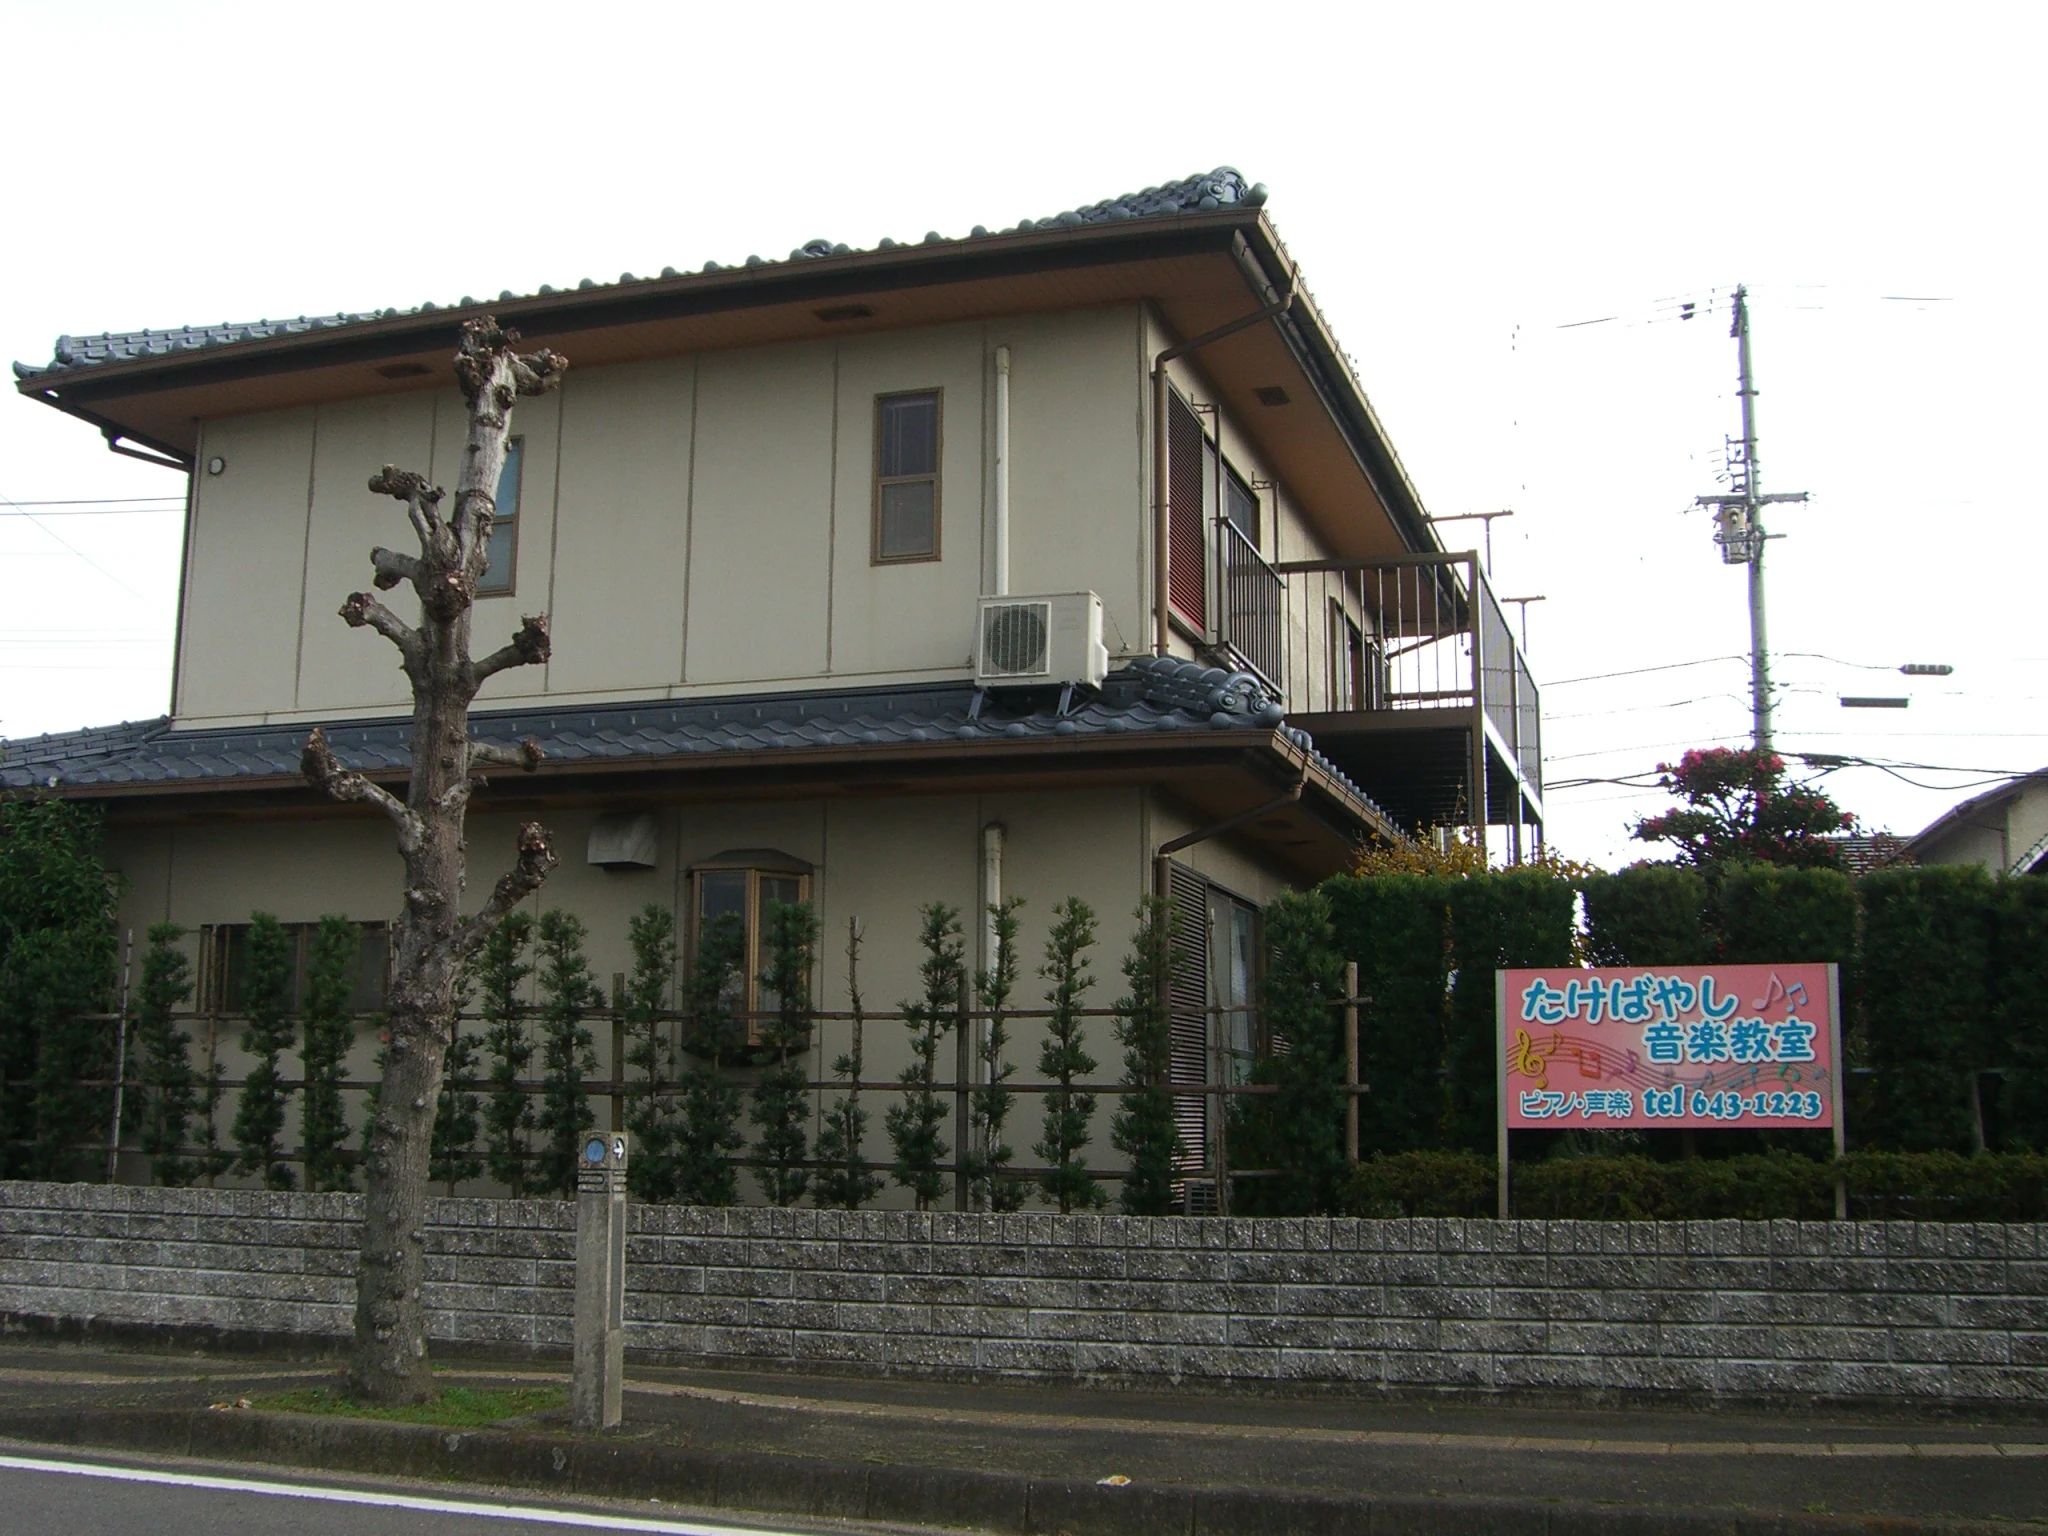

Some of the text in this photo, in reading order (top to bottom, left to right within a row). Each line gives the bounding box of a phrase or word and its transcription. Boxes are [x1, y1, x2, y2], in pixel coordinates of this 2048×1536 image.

[1522, 972, 1737, 1023] たけばやし
[1643, 1016, 1817, 1063] 音楽教室
[1520, 1084, 1821, 1120] ピアノ・声楽 tel 643-1223
